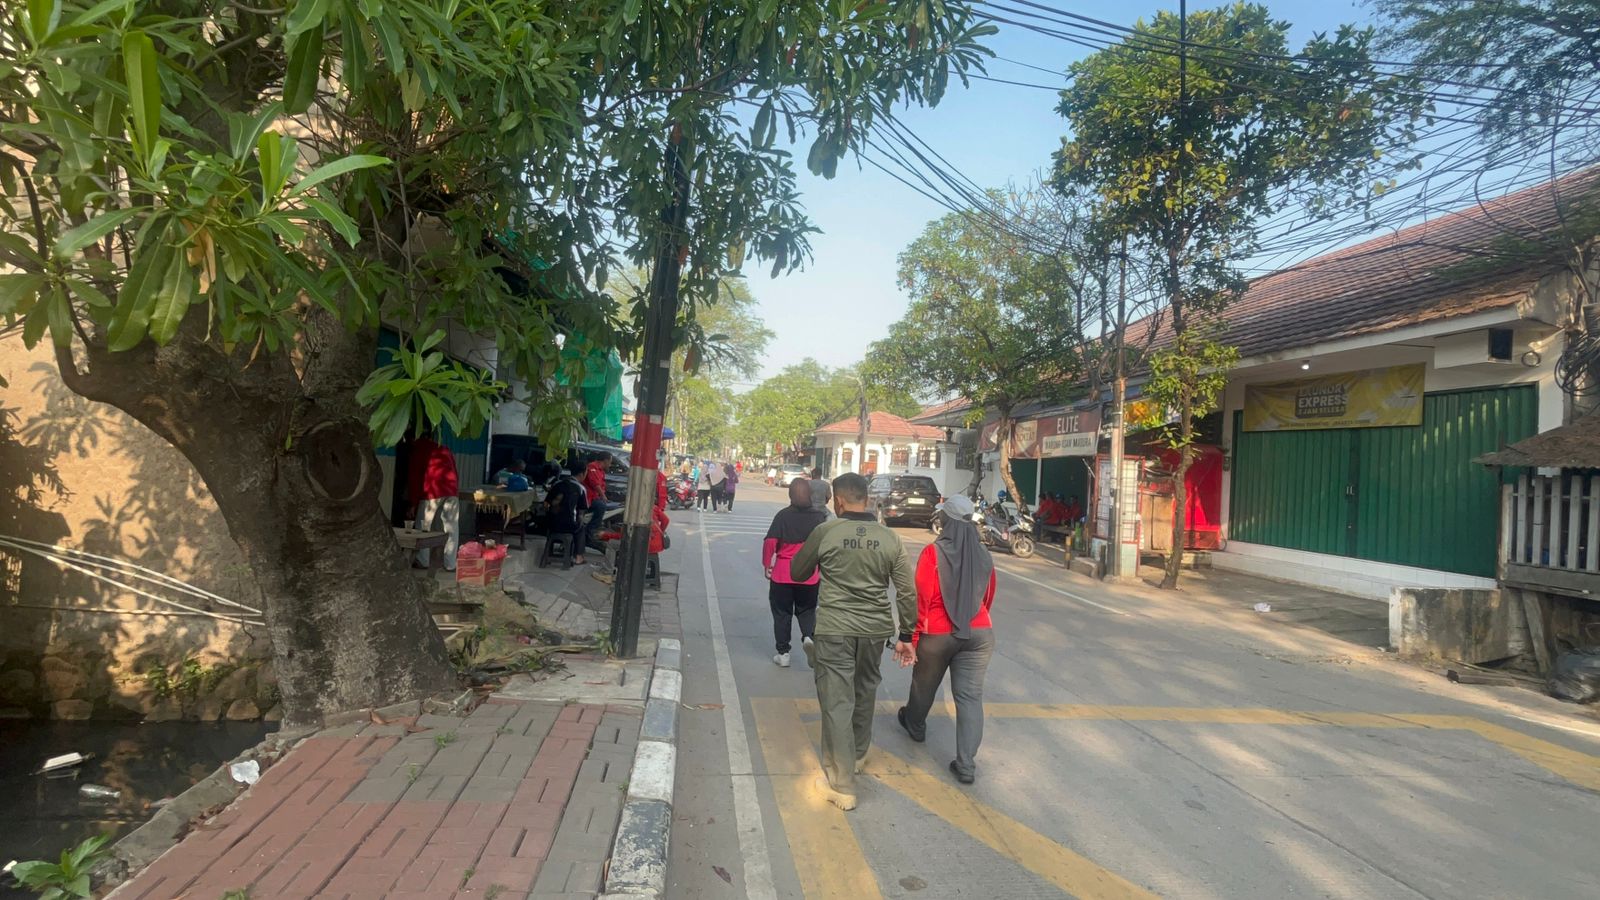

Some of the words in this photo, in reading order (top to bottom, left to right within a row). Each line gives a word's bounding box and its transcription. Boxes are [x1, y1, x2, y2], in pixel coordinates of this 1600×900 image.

[1298, 394, 1349, 408] EXPRESS
[1056, 415, 1079, 434] ELITE
[843, 538, 864, 550] POL
[866, 539, 880, 550] PP
